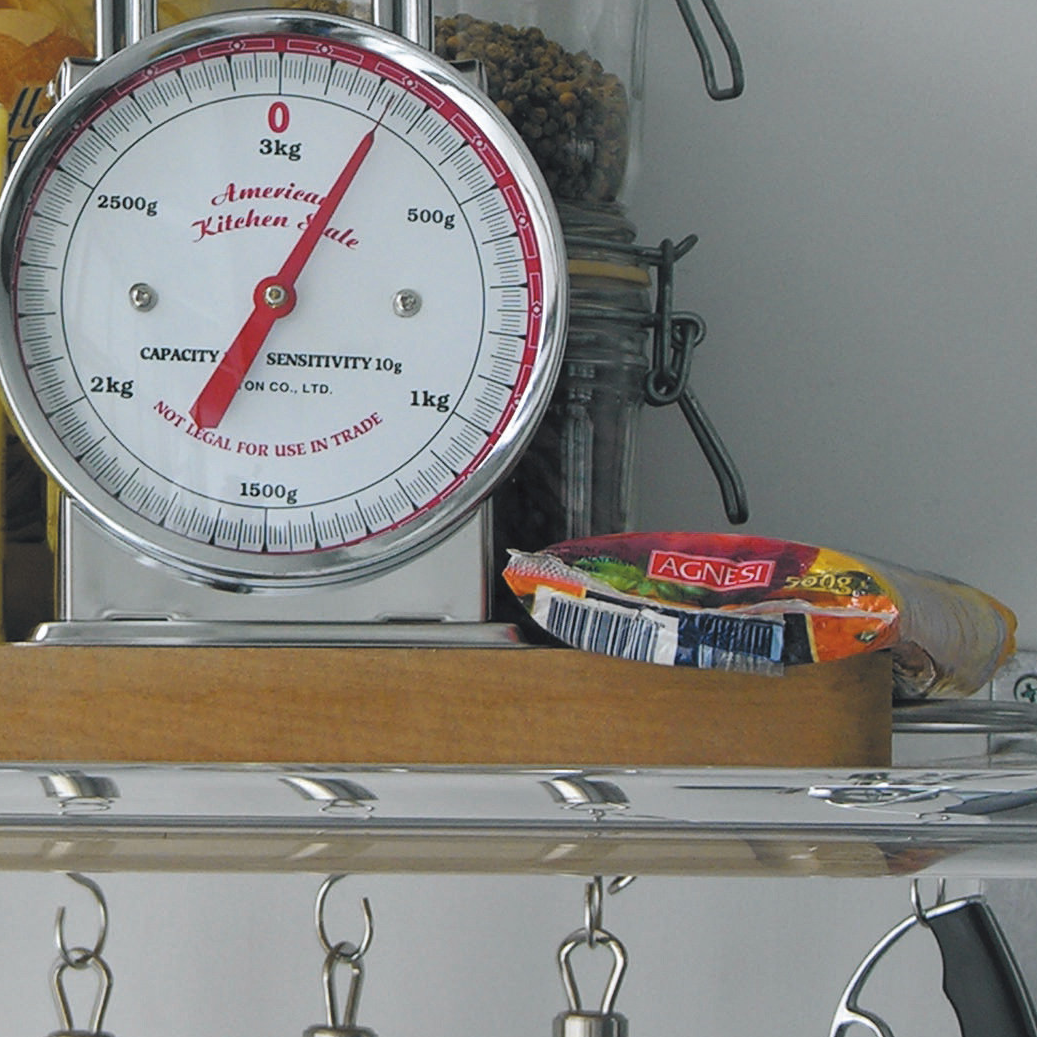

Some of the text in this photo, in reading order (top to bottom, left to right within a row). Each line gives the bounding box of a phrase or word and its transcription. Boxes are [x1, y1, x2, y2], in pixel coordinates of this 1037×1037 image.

[267, 101, 291, 134] 0
[258, 138, 303, 162] 3kg
[97, 194, 159, 217] 2500g
[191, 208, 360, 251] Kitchen Sale
[406, 208, 456, 229] 500g
[140, 346, 220, 363] CAPACITY
[266, 351, 403, 375] SENSITIVITY 10g
[90, 375, 134, 400] 2kg
[269, 381, 299, 395] CO.,
[302, 383, 334, 395] LTD.
[409, 390, 451, 413] 1kg
[153, 400, 384, 458] NOT LEGAL FOR USE IN TRADE
[239, 481, 299, 504] 1500g
[656, 558, 765, 586] AGNESI
[784, 573, 855, 596] 500g
